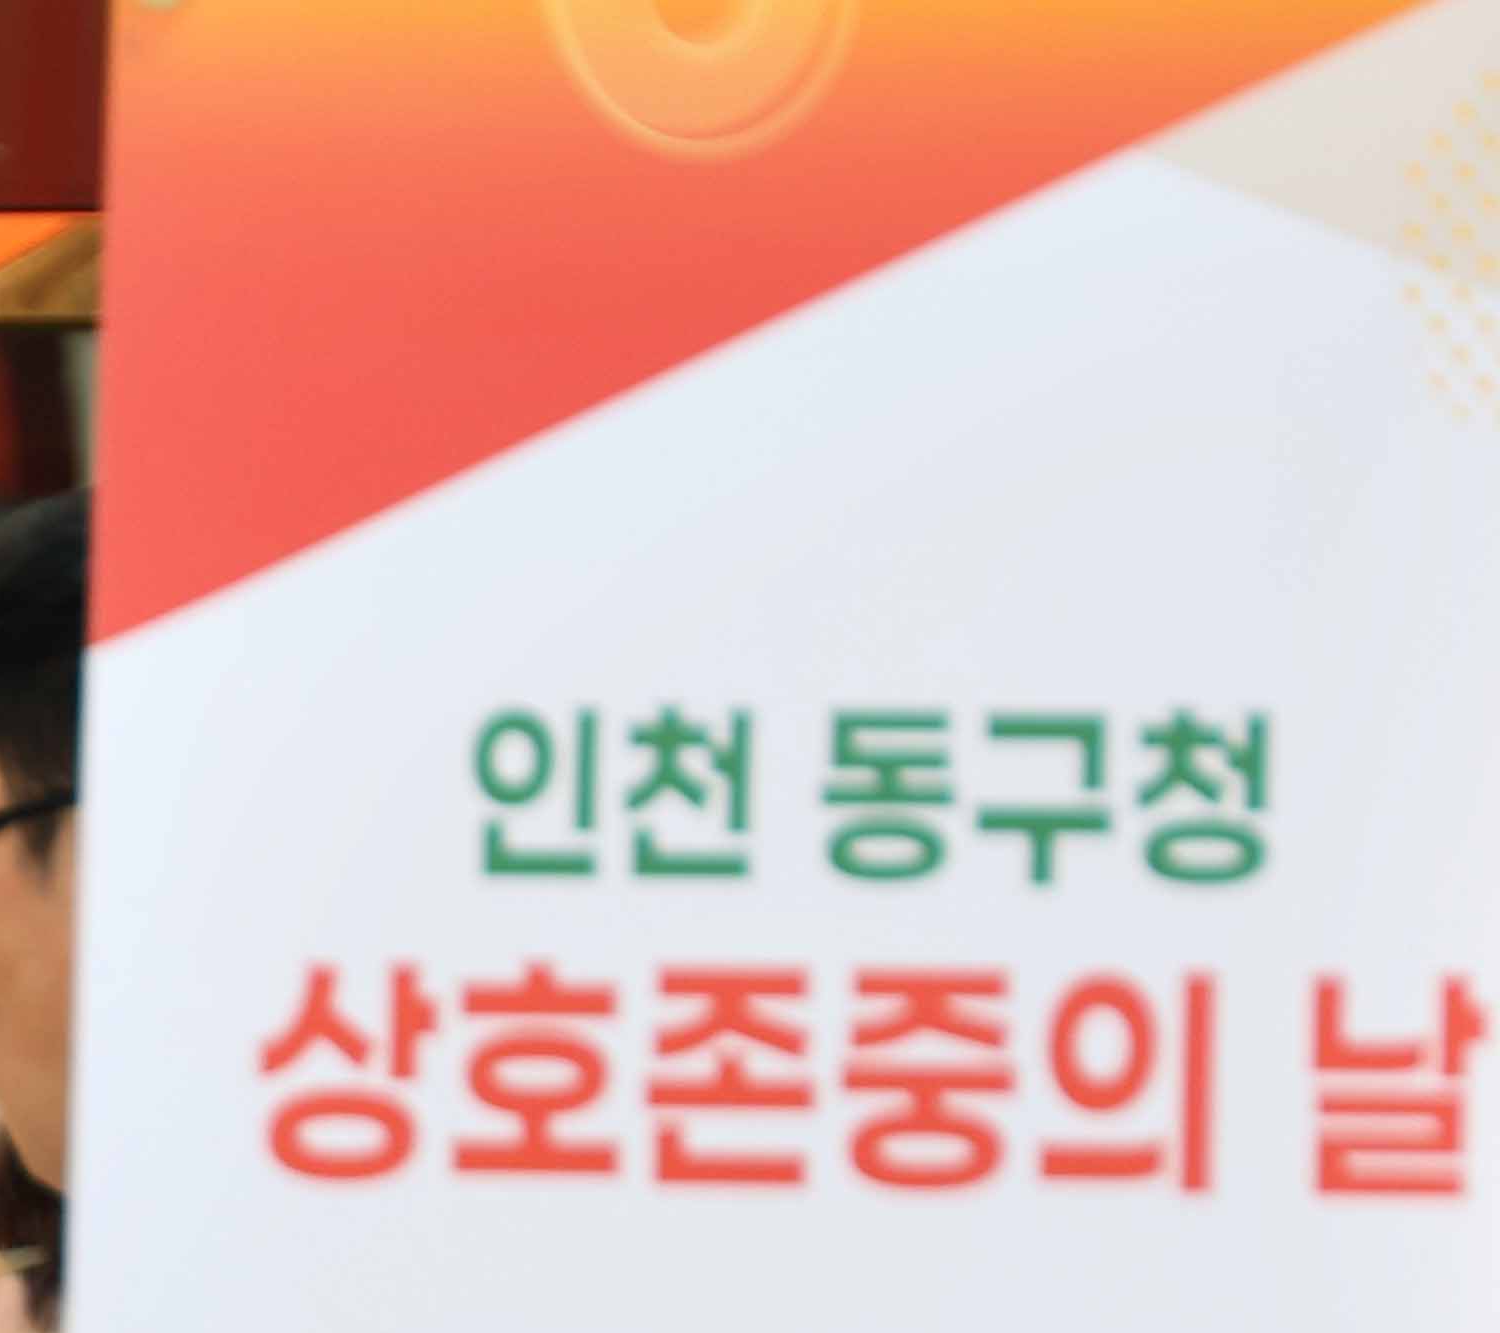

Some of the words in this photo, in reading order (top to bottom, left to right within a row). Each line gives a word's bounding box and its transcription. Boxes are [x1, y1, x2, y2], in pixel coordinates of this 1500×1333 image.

[470, 703, 754, 880] 인천
[818, 706, 1274, 888] 동구청
[255, 958, 1217, 1194] 상호존중의
[1308, 968, 1488, 1198] 날
